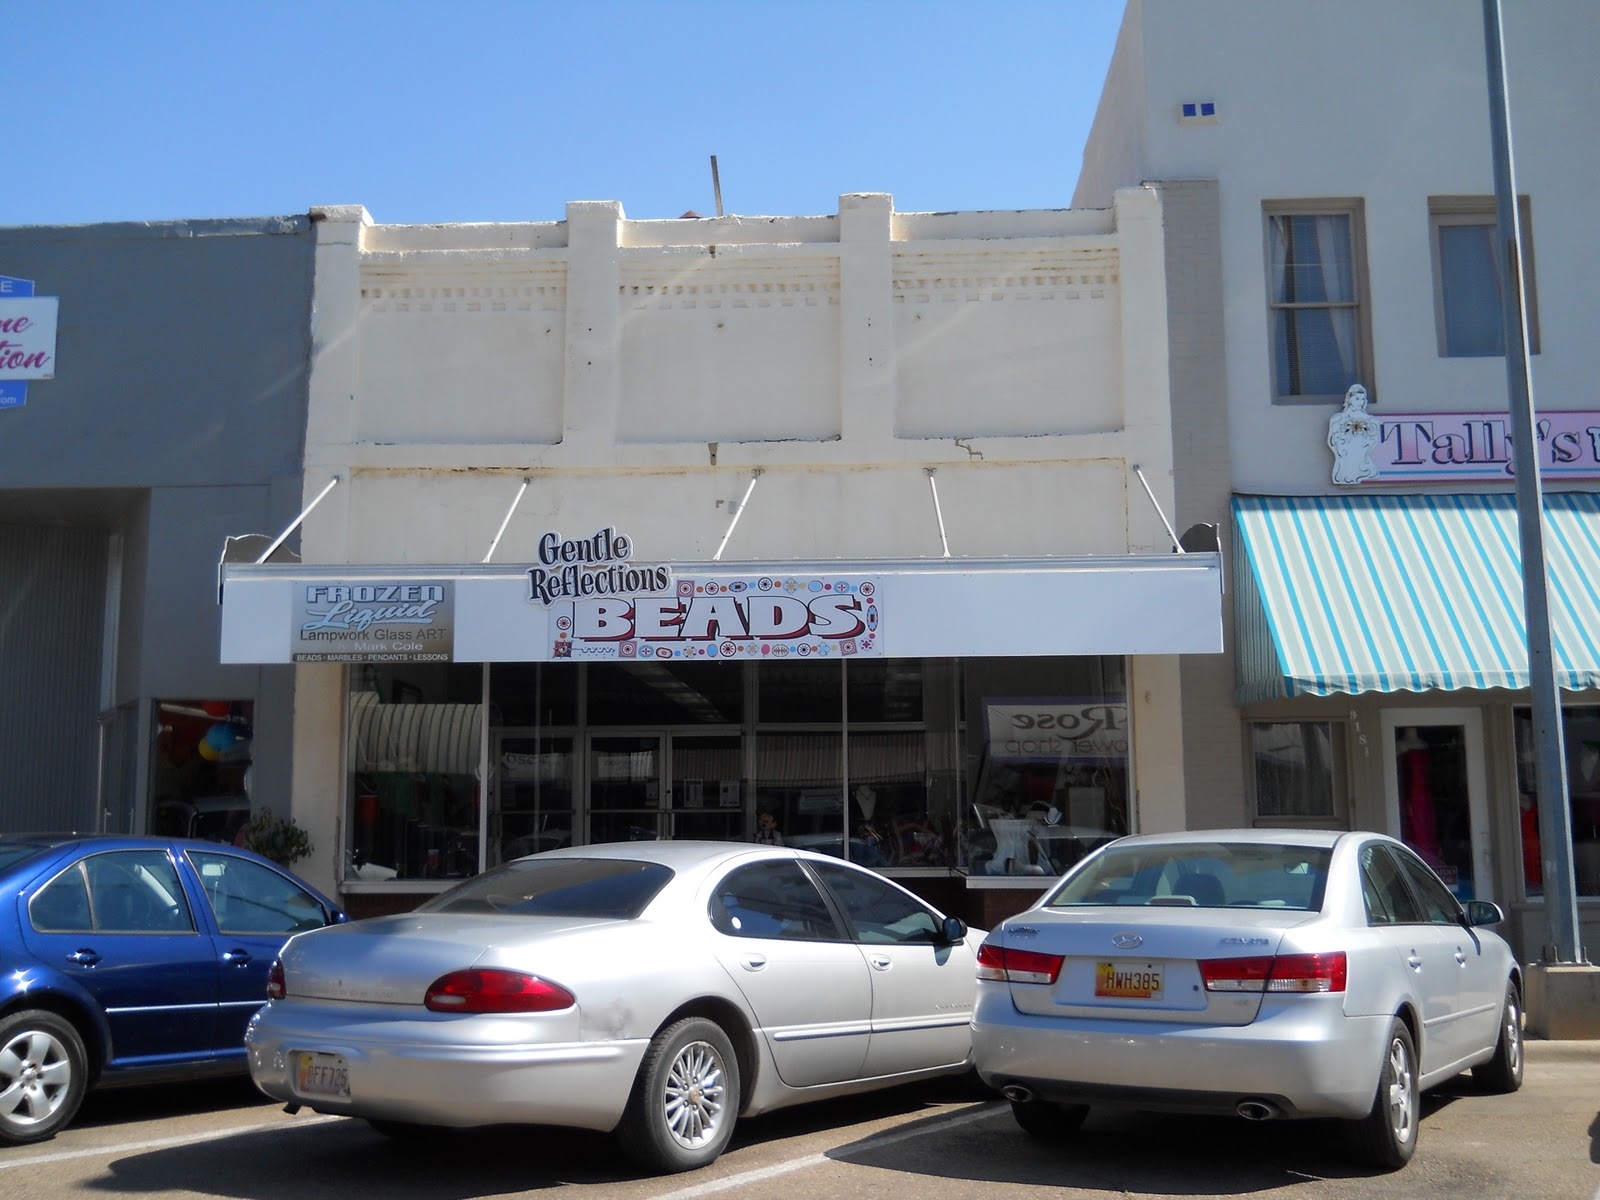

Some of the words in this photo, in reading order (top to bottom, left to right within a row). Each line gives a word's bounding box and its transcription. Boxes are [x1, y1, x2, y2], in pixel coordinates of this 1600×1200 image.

[539, 527, 628, 565] Gentle
[529, 562, 669, 605] Reflections
[302, 600, 438, 632] Liquid
[572, 594, 866, 642] BEADS
[300, 629, 370, 643] Lampwork
[374, 628, 413, 641] Glass
[416, 628, 447, 640] ART
[354, 642, 388, 651] Mark
[392, 642, 424, 651] Cole
[296, 654, 322, 662] BEADS
[327, 654, 363, 662] MARBLES
[368, 653, 408, 662] PENDANTS
[413, 653, 449, 661] LESSONS
[1106, 971, 1160, 991] HWH385
